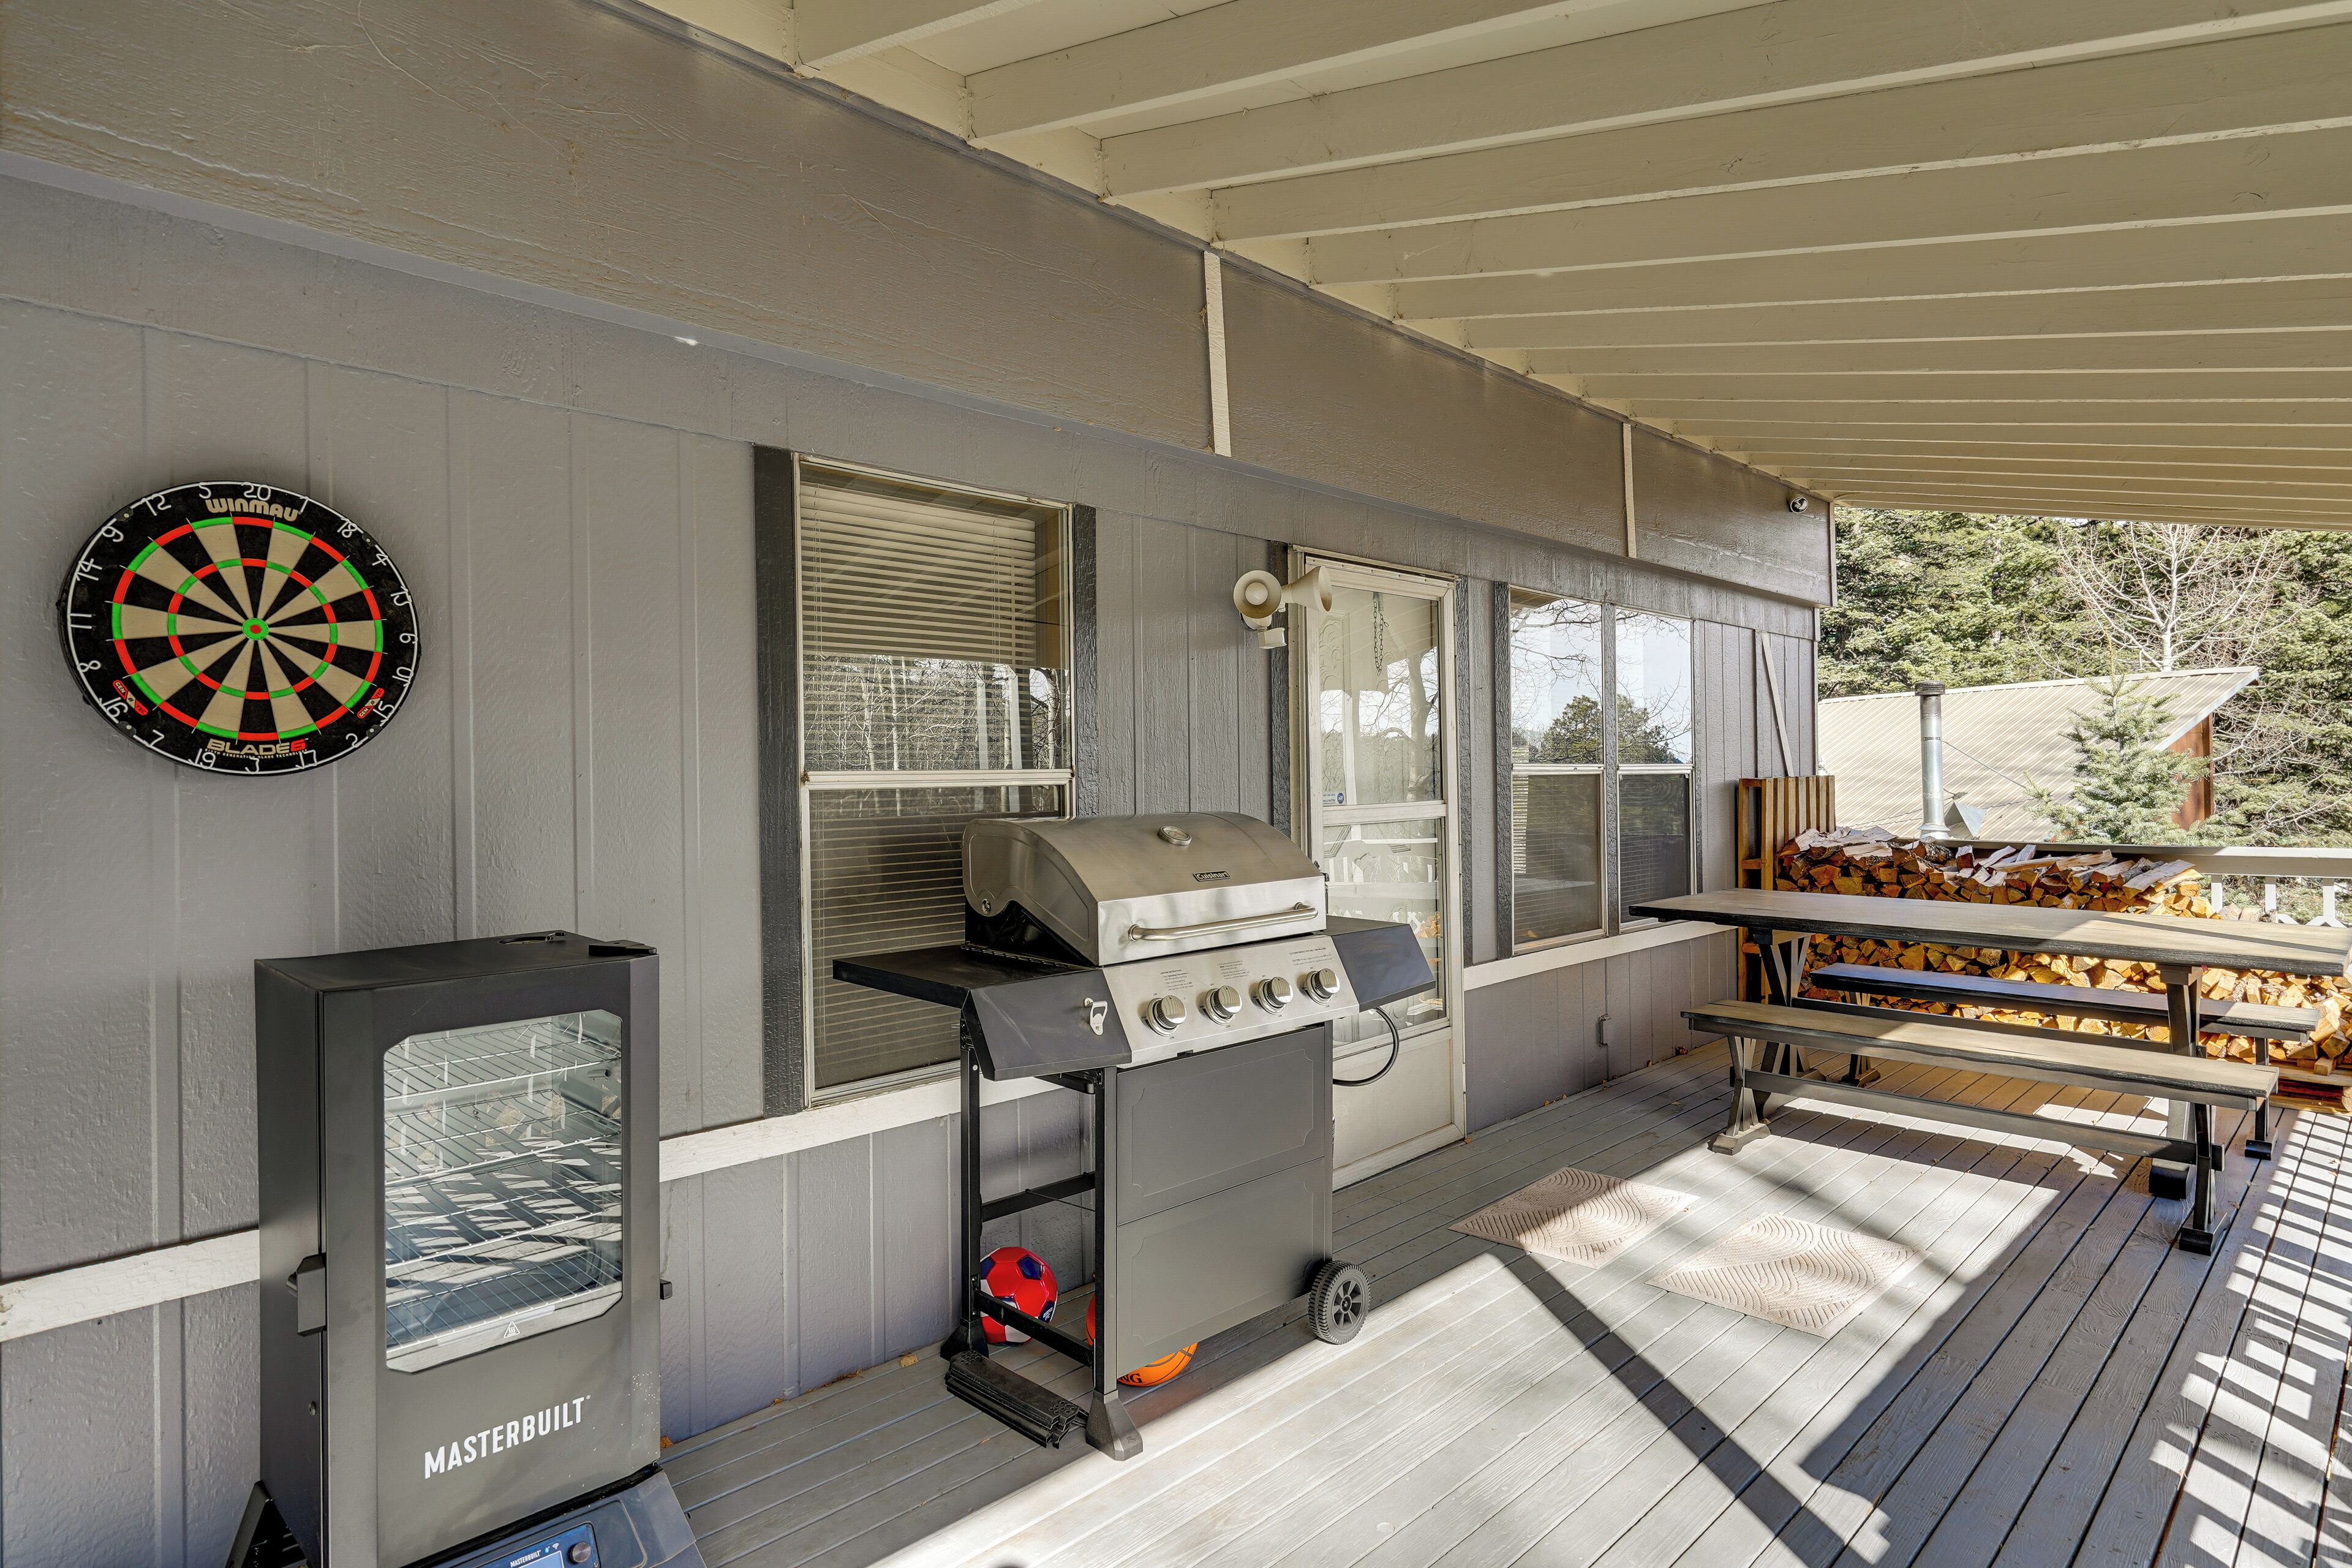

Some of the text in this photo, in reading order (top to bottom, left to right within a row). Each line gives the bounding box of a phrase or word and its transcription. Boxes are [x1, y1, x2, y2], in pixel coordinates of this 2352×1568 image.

[198, 481, 212, 499] 5
[241, 481, 271, 501] 20
[141, 494, 172, 516] 12
[205, 498, 299, 522] WINMAU
[299, 496, 309, 513] 1
[100, 526, 124, 543] 9
[337, 518, 358, 538] 18
[75, 558, 103, 581] 14
[372, 553, 389, 567] 4
[390, 586, 412, 606] 13
[67, 612, 92, 630] 11
[77, 660, 102, 673] 8
[392, 666, 414, 687] 10
[115, 681, 126, 693] GEN
[99, 696, 129, 718] 16
[372, 700, 395, 723] 15
[148, 729, 165, 747] 7
[206, 738, 306, 755] BLADE6
[345, 733, 364, 748] 2
[188, 748, 217, 769] 19
[245, 756, 260, 775] 3
[295, 749, 317, 769] 17
[424, 1396, 586, 1480] MASTERBUILT
[510, 1549, 541, 1568] MASTERBUILT
